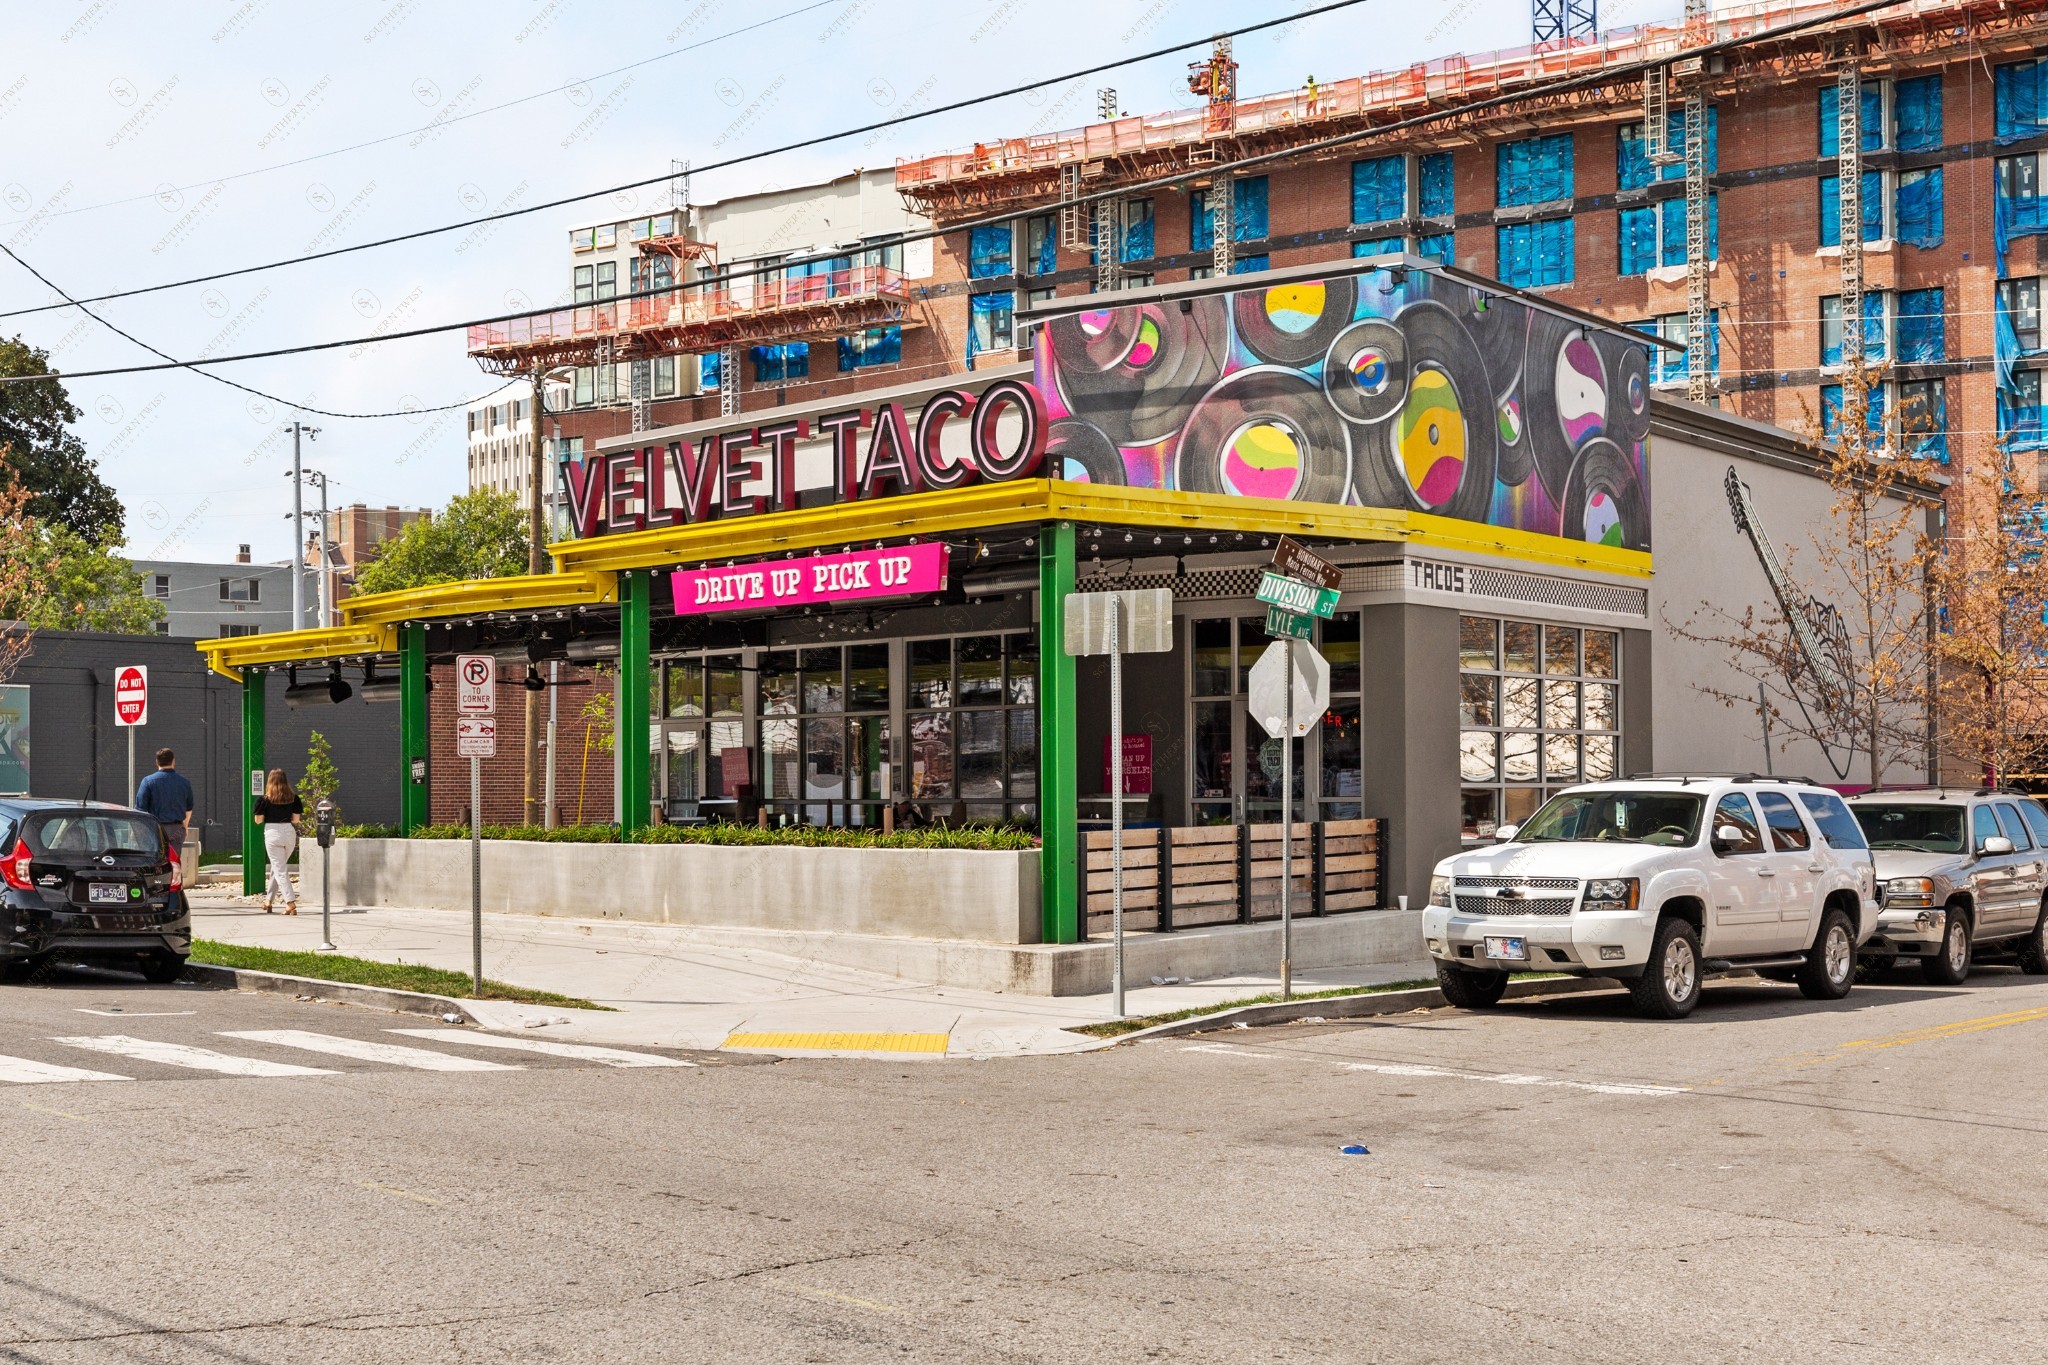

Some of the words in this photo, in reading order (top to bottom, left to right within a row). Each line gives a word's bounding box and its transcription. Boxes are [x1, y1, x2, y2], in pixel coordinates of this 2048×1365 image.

[560, 419, 808, 539] VELVET
[819, 379, 1047, 499] TACO
[1297, 548, 1325, 572] HONORARY
[694, 571, 764, 605] DRIVE
[770, 568, 801, 597] UP
[812, 560, 871, 593] PICK
[878, 556, 912, 586] UP
[1300, 563, 1317, 580] Ferrari
[1316, 572, 1327, 587] Way
[1411, 560, 1463, 592] TACOS
[1260, 577, 1320, 610] DIVISION
[1321, 602, 1334, 614] ST
[1268, 610, 1294, 634] LYLE
[1297, 627, 1310, 639] AVE
[120, 679, 128, 688] DO
[131, 678, 142, 687] NOT
[122, 704, 139, 713] ENTER
[412, 769, 425, 777] FREE
[1106, 766, 1150, 775] YRSELF!
[109, 889, 125, 898] 5920
